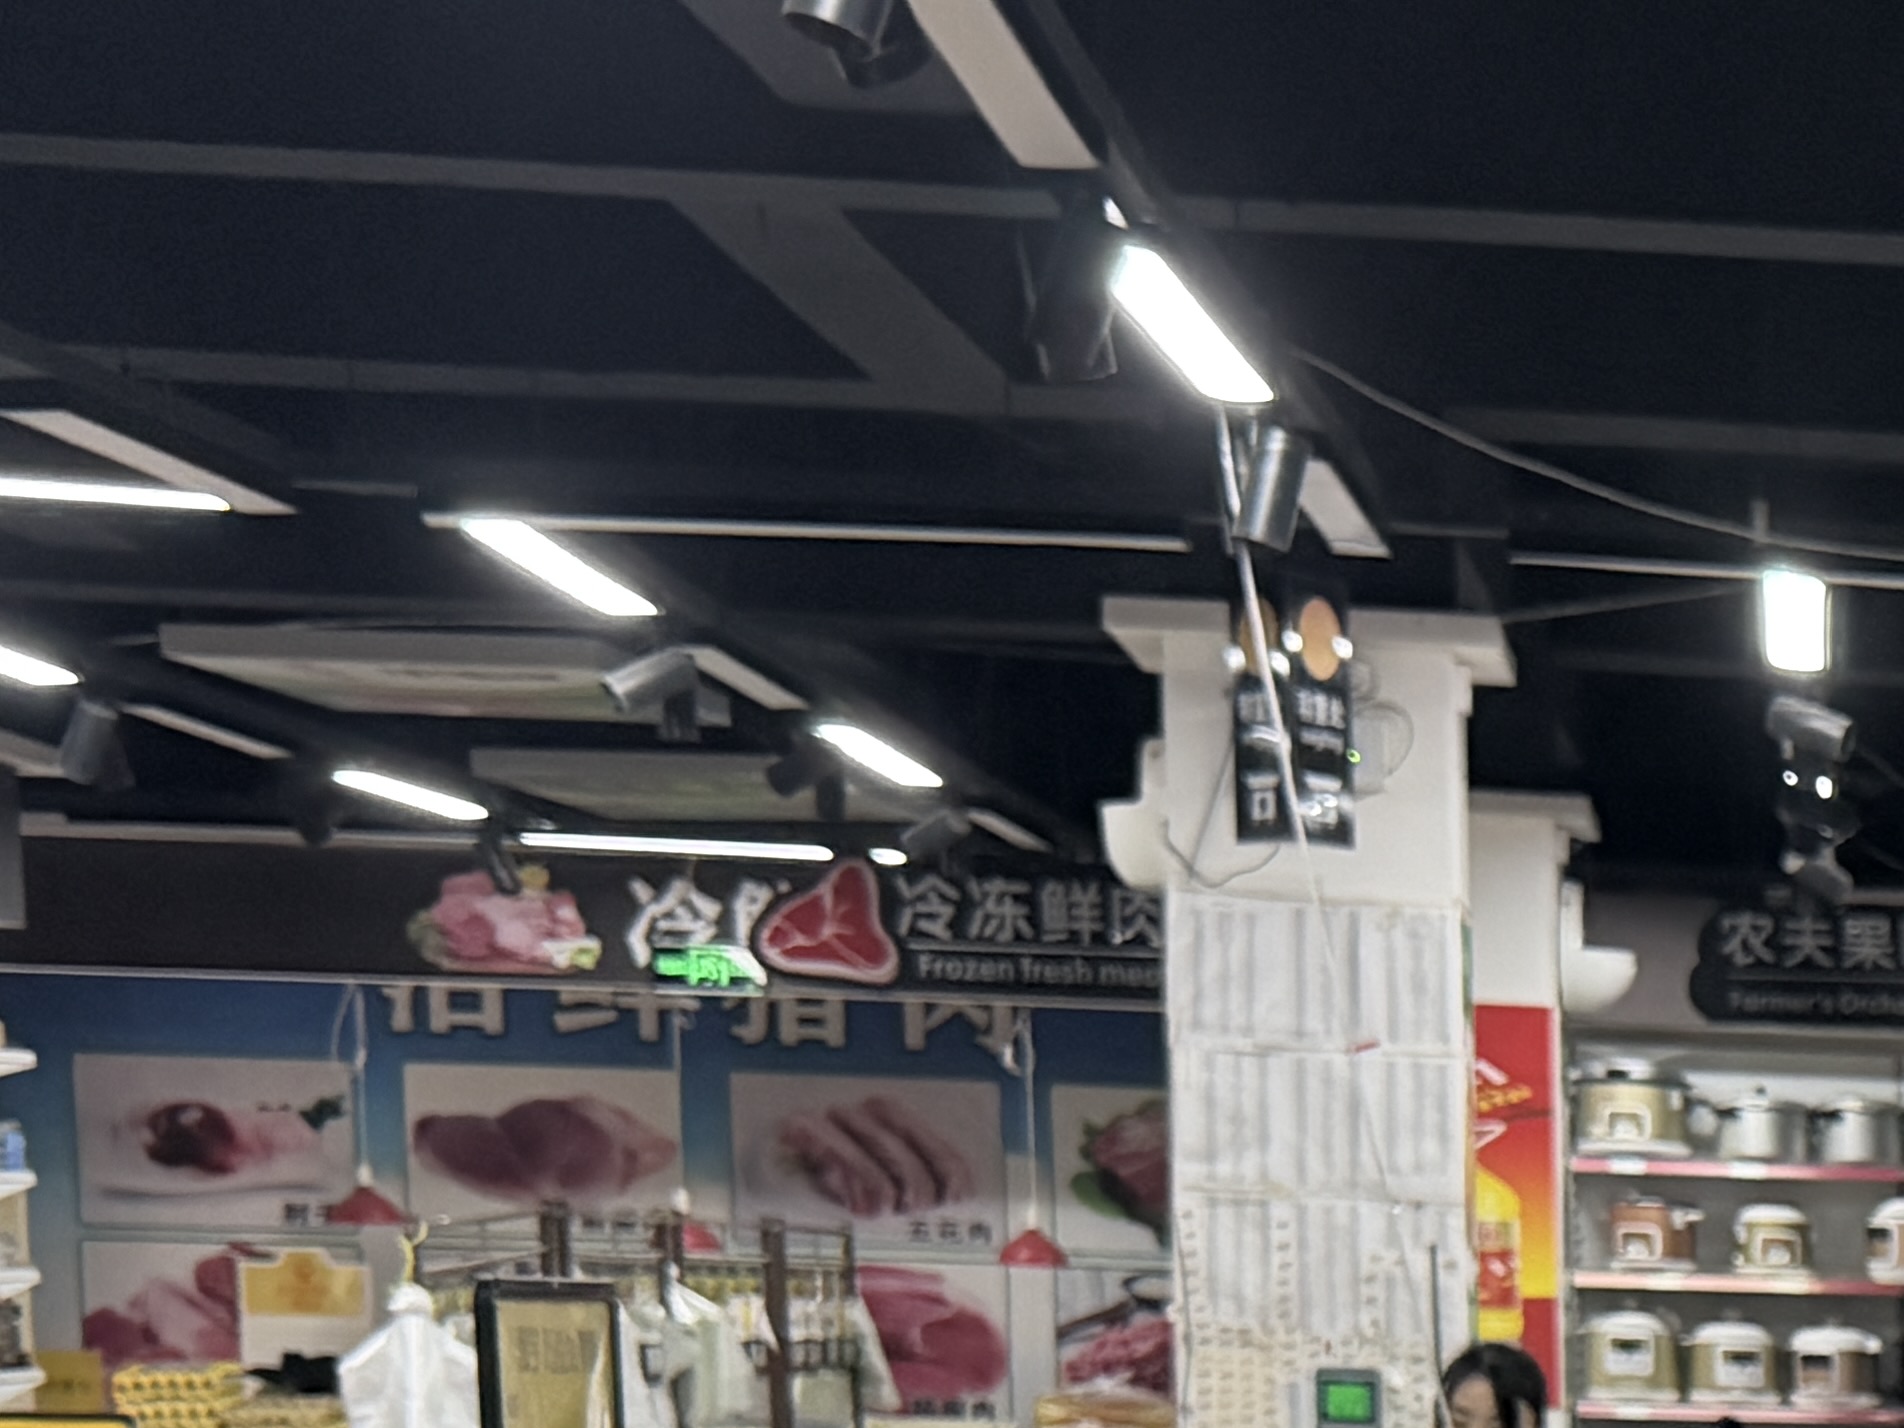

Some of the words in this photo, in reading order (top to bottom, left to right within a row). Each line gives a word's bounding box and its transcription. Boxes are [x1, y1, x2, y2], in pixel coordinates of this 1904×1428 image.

[896, 875, 1163, 946] 冷冻鲜肉
[919, 955, 1017, 980] Frozen
[1024, 957, 1092, 985] fresh
[1098, 963, 1160, 986] mea
